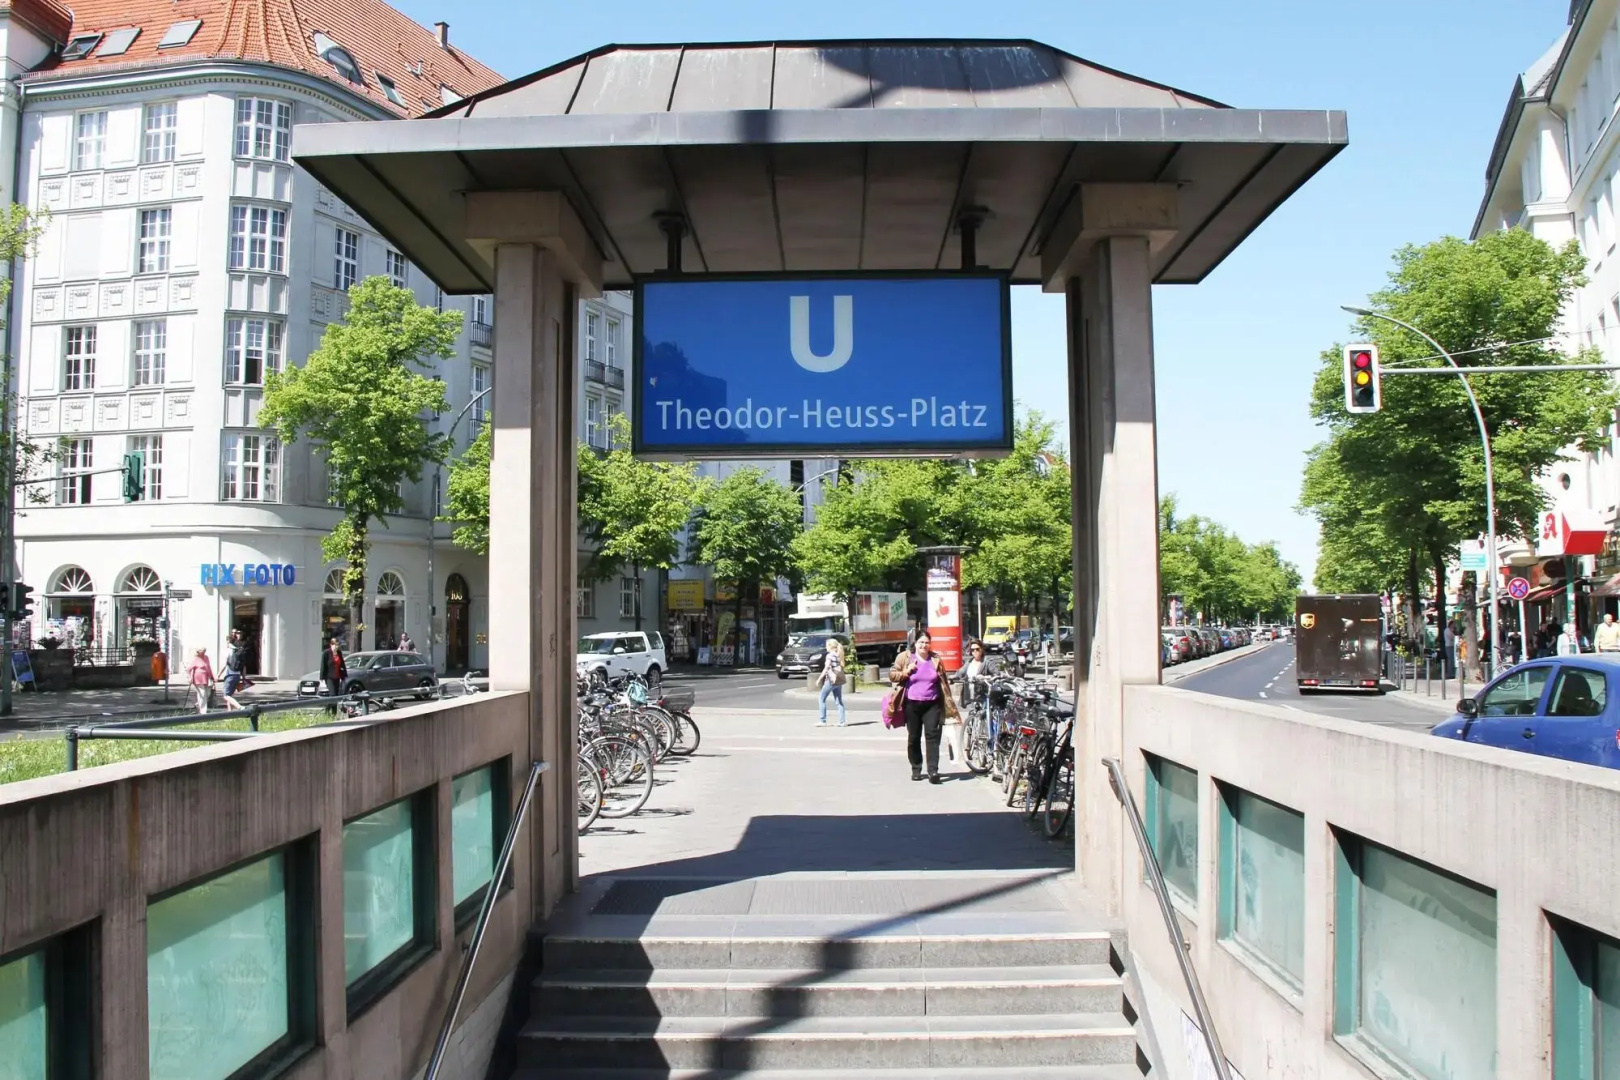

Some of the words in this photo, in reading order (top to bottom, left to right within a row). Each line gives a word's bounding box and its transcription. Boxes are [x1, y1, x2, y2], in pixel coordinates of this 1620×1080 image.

[789, 295, 853, 373] U
[655, 397, 987, 430] Theodor-Heuss-Platz
[243, 563, 296, 586] FOTO
